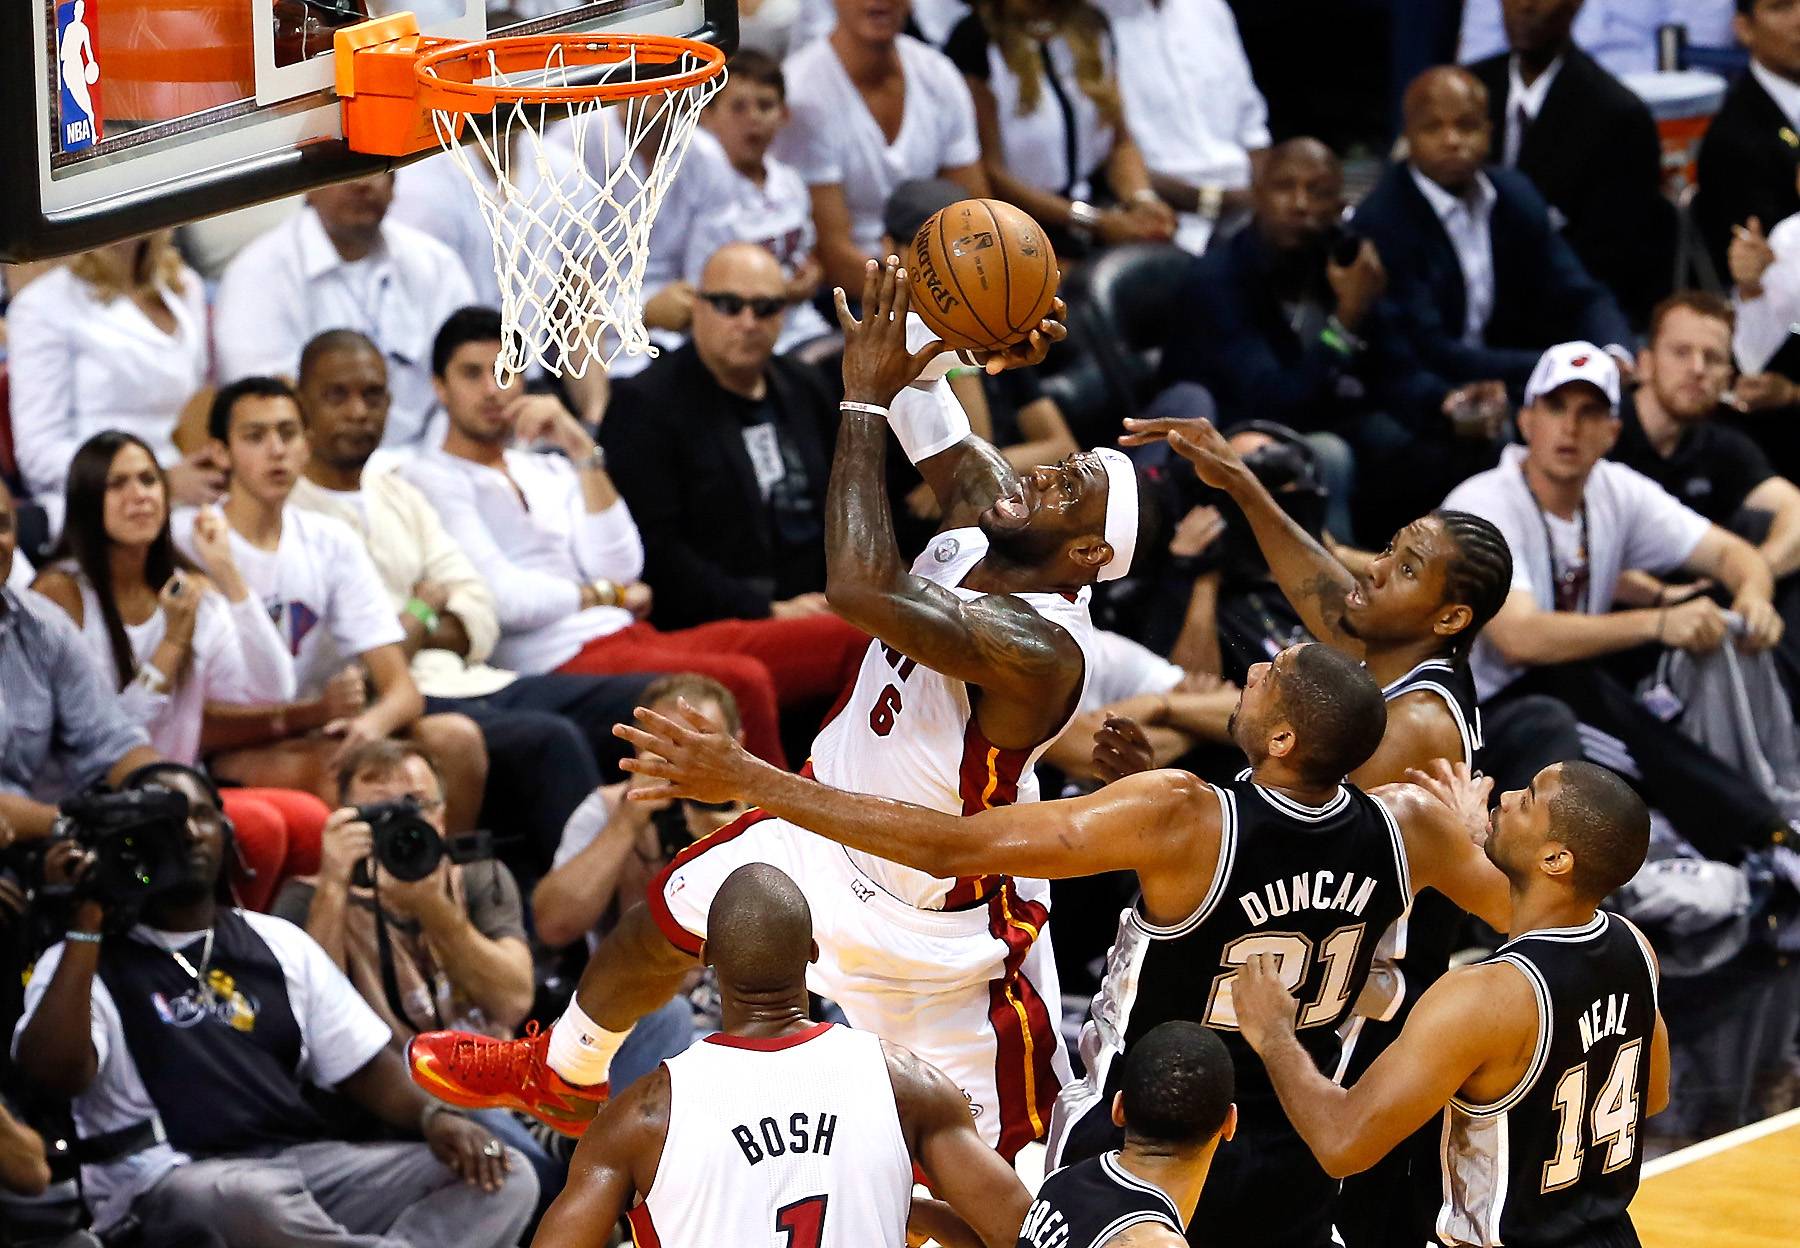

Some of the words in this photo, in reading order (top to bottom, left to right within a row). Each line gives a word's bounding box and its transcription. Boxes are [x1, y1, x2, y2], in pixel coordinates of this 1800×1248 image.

[66, 118, 91, 145] NBA
[870, 683, 903, 737] 6
[1238, 870, 1378, 927] DUNCAN
[1200, 922, 1367, 1032] 21
[1578, 993, 1630, 1054] NEAL
[731, 1112, 838, 1166] BOSH
[1540, 1037, 1643, 1195] 14
